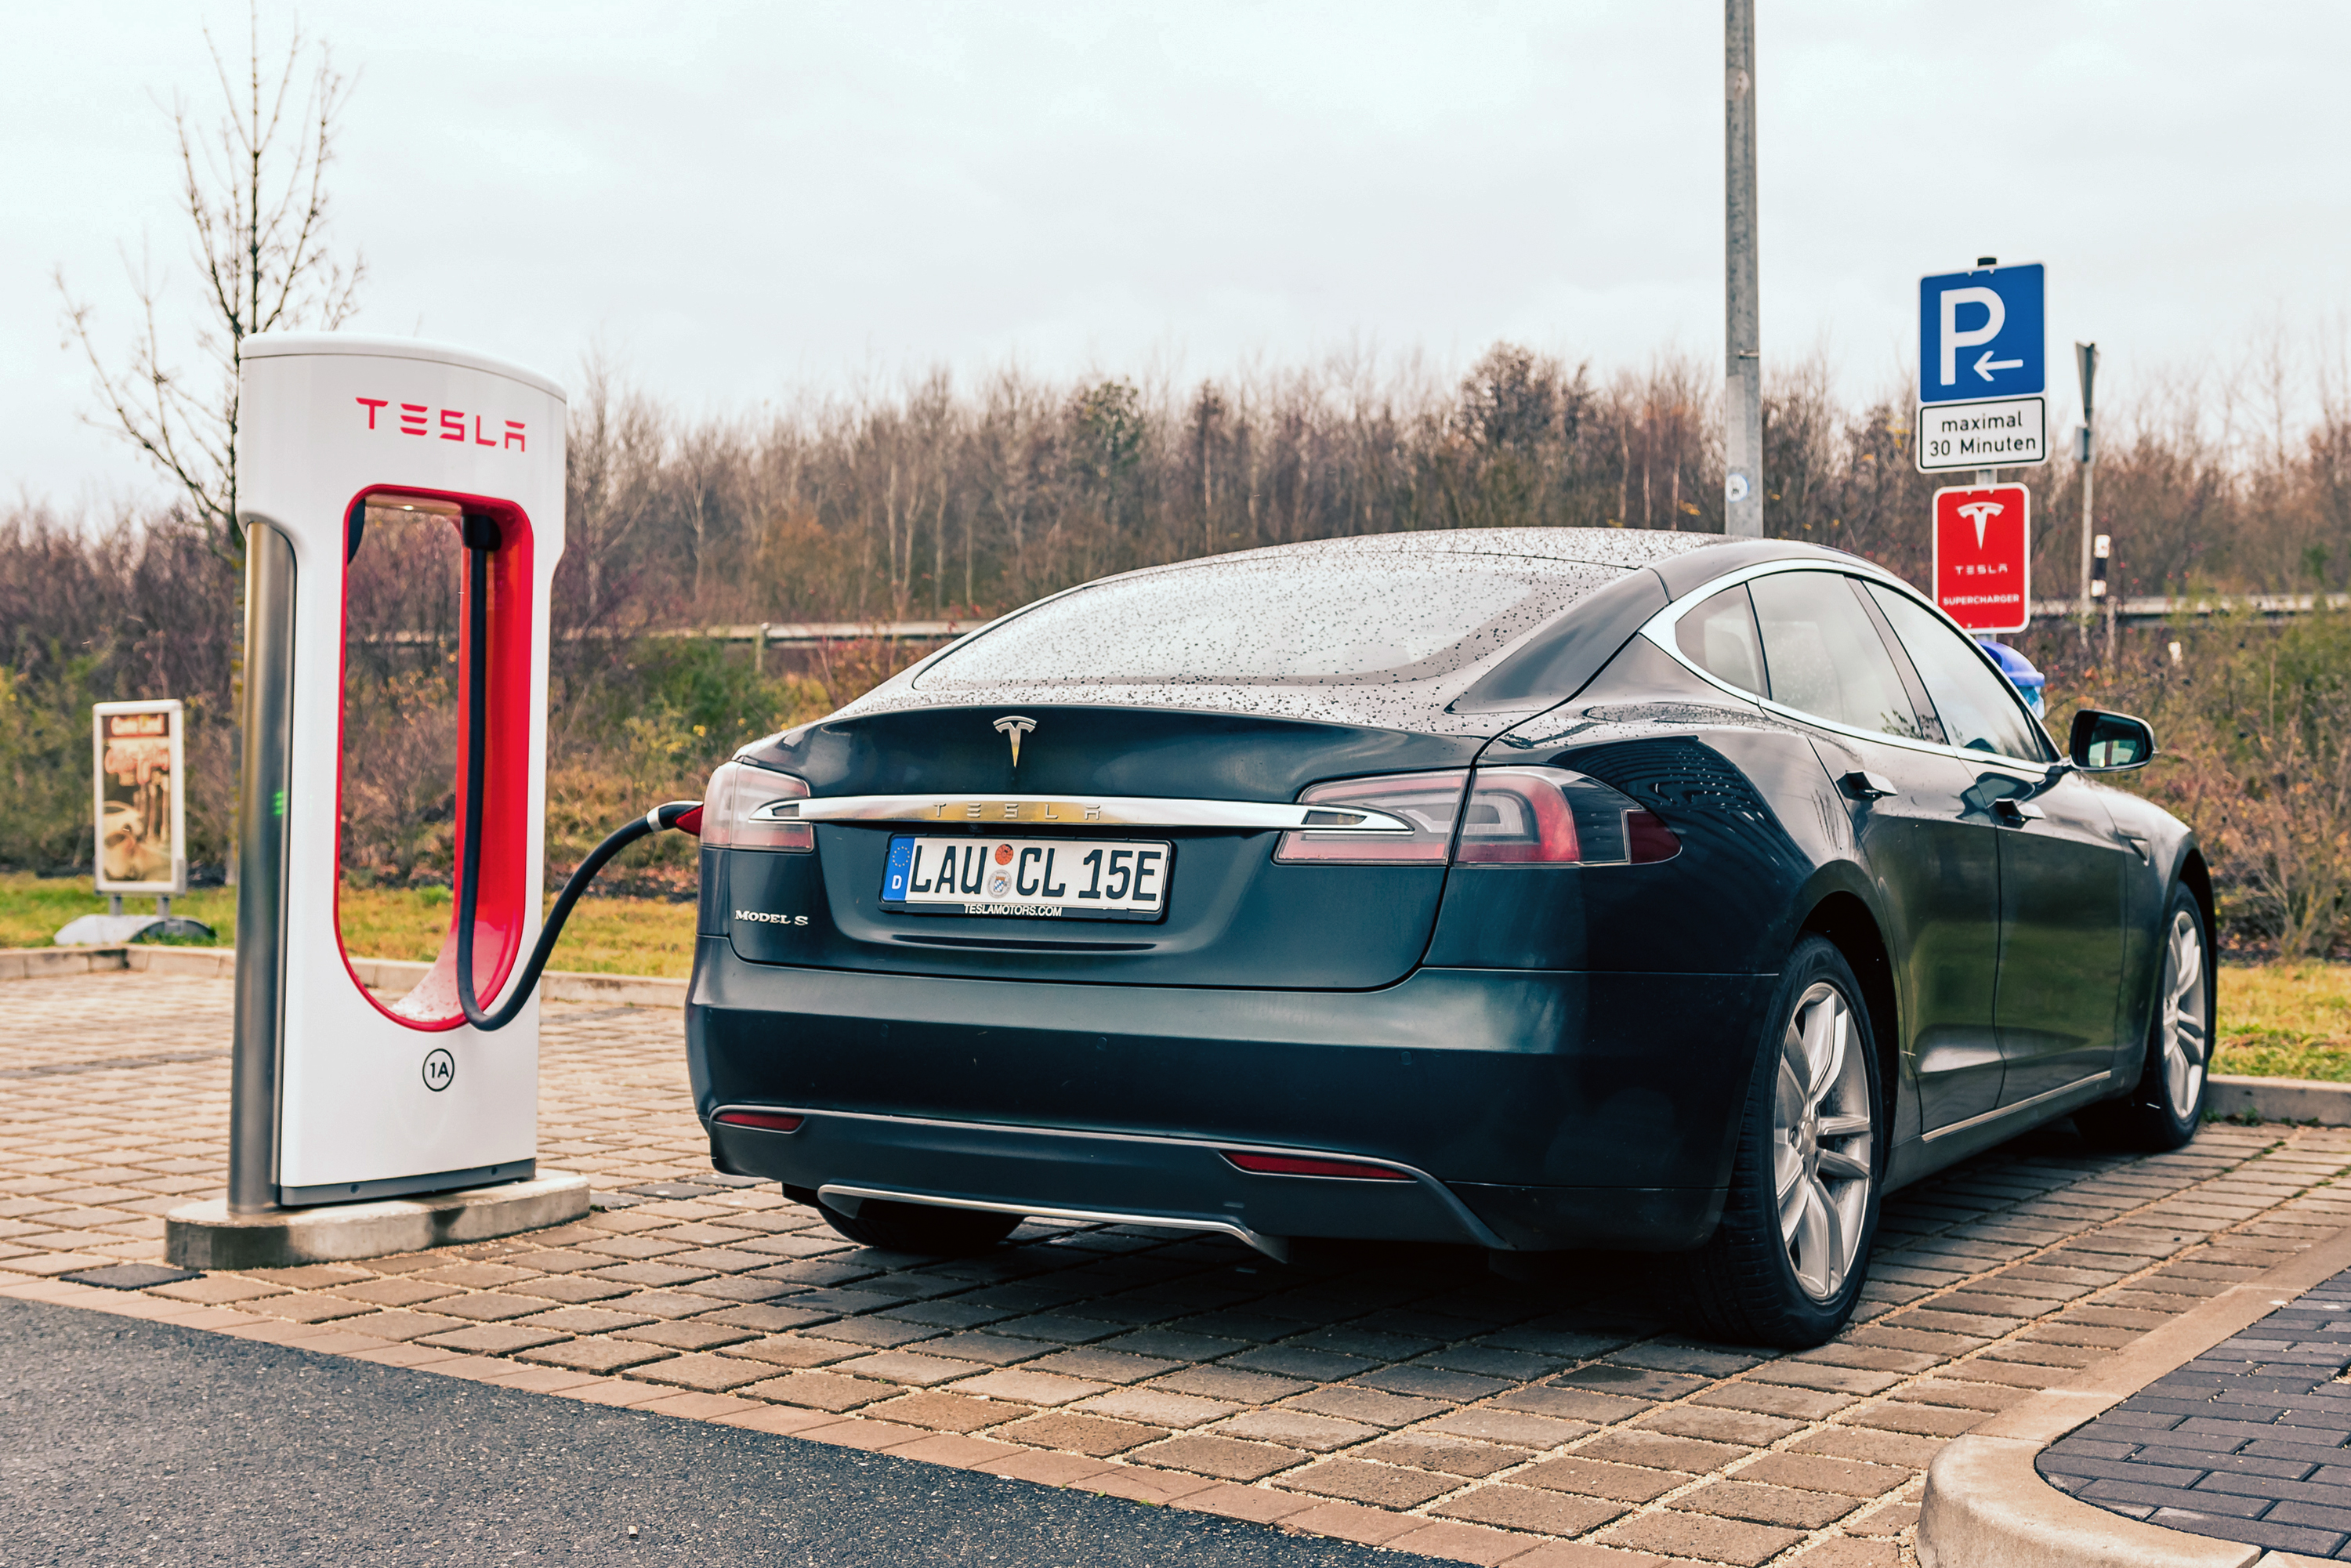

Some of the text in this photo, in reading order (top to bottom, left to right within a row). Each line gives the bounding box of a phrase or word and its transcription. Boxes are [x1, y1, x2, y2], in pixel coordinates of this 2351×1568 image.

[1940, 286, 2005, 386] P
[355, 397, 526, 452] TESLA
[1942, 411, 2023, 432] maximal
[1930, 436, 2036, 456] 30 Minuten
[1954, 563, 2008, 575] TESLA
[1943, 594, 2020, 606] SUPERCHARGER
[933, 802, 1101, 820] TESLA
[891, 875, 902, 889] D
[910, 845, 988, 894] LAU
[1016, 847, 1066, 897] CL
[1078, 849, 1162, 902] 15E
[735, 910, 808, 925] MODEL S
[964, 904, 1062, 917] TESLAMOTORS.COM
[429, 1062, 449, 1078] 1A
